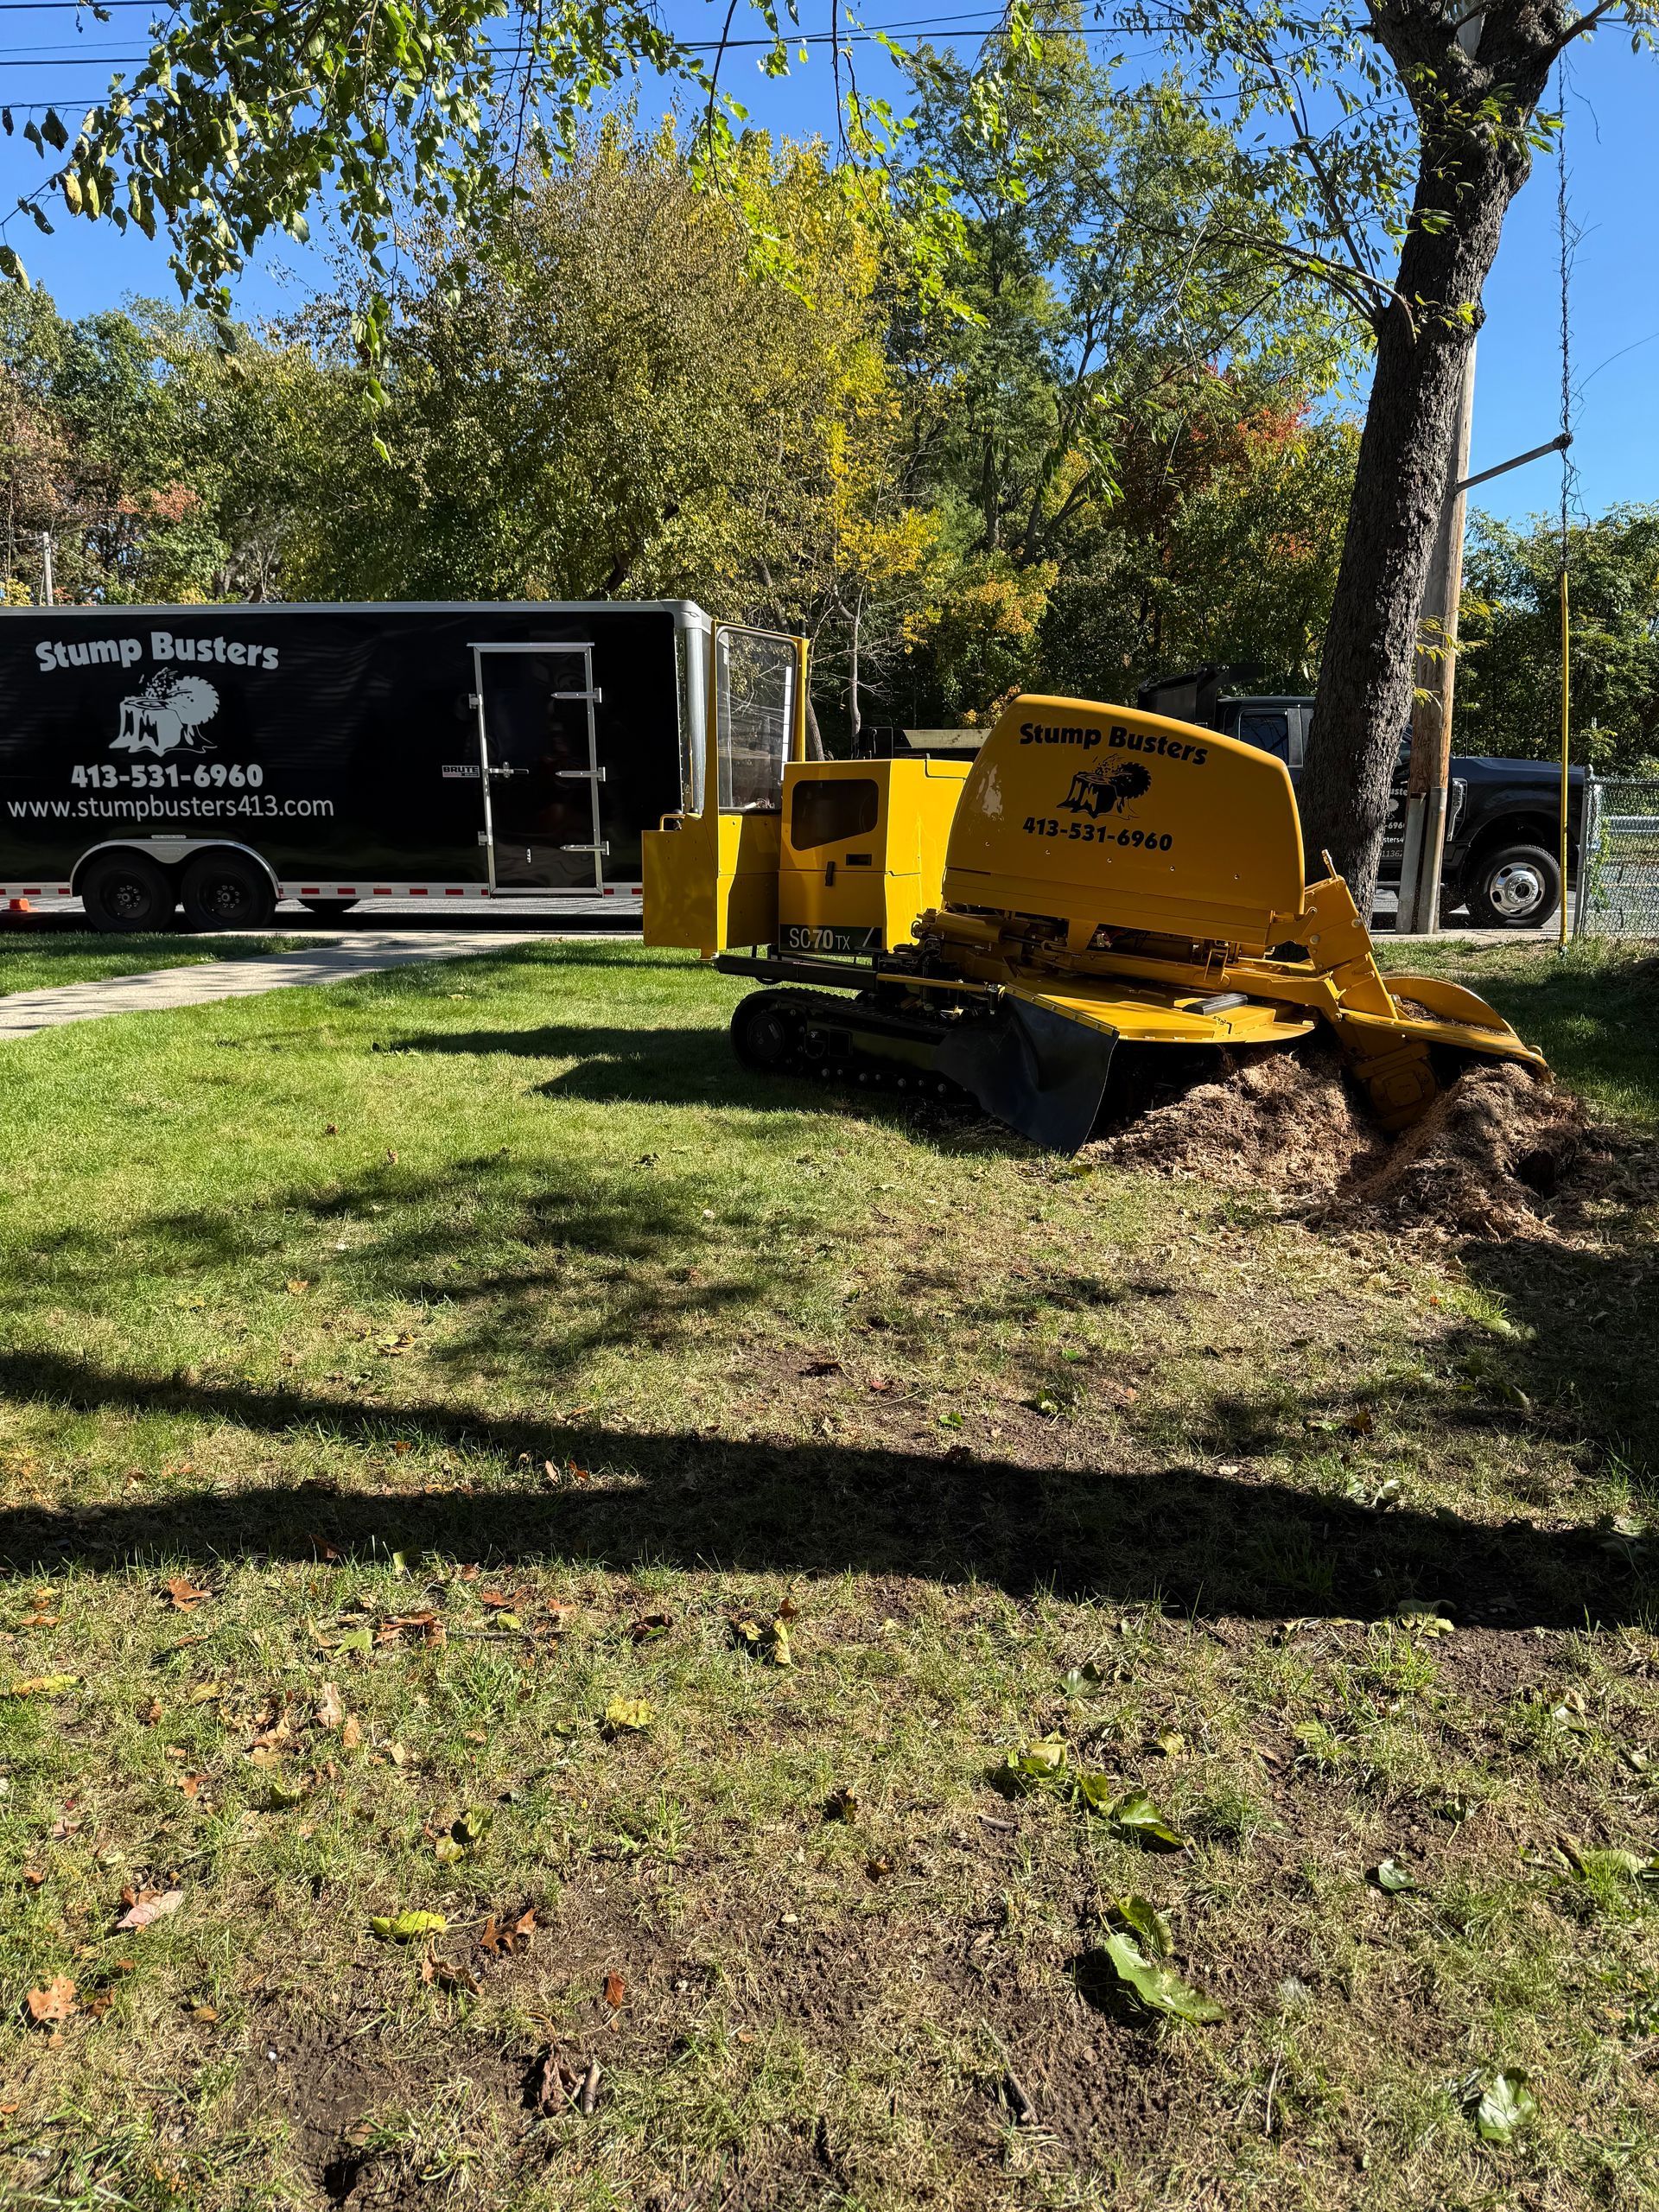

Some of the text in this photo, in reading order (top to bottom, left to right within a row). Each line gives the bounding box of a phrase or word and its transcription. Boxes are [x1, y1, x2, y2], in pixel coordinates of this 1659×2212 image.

[35, 632, 279, 671] Stump Busters
[1020, 722, 1209, 766] Stump Busters
[71, 764, 264, 788] 413-531-6960
[1389, 787, 1408, 796] uste
[7, 795, 334, 822] www.stumpbusters413.com
[1022, 817, 1173, 851] 413-531-6960
